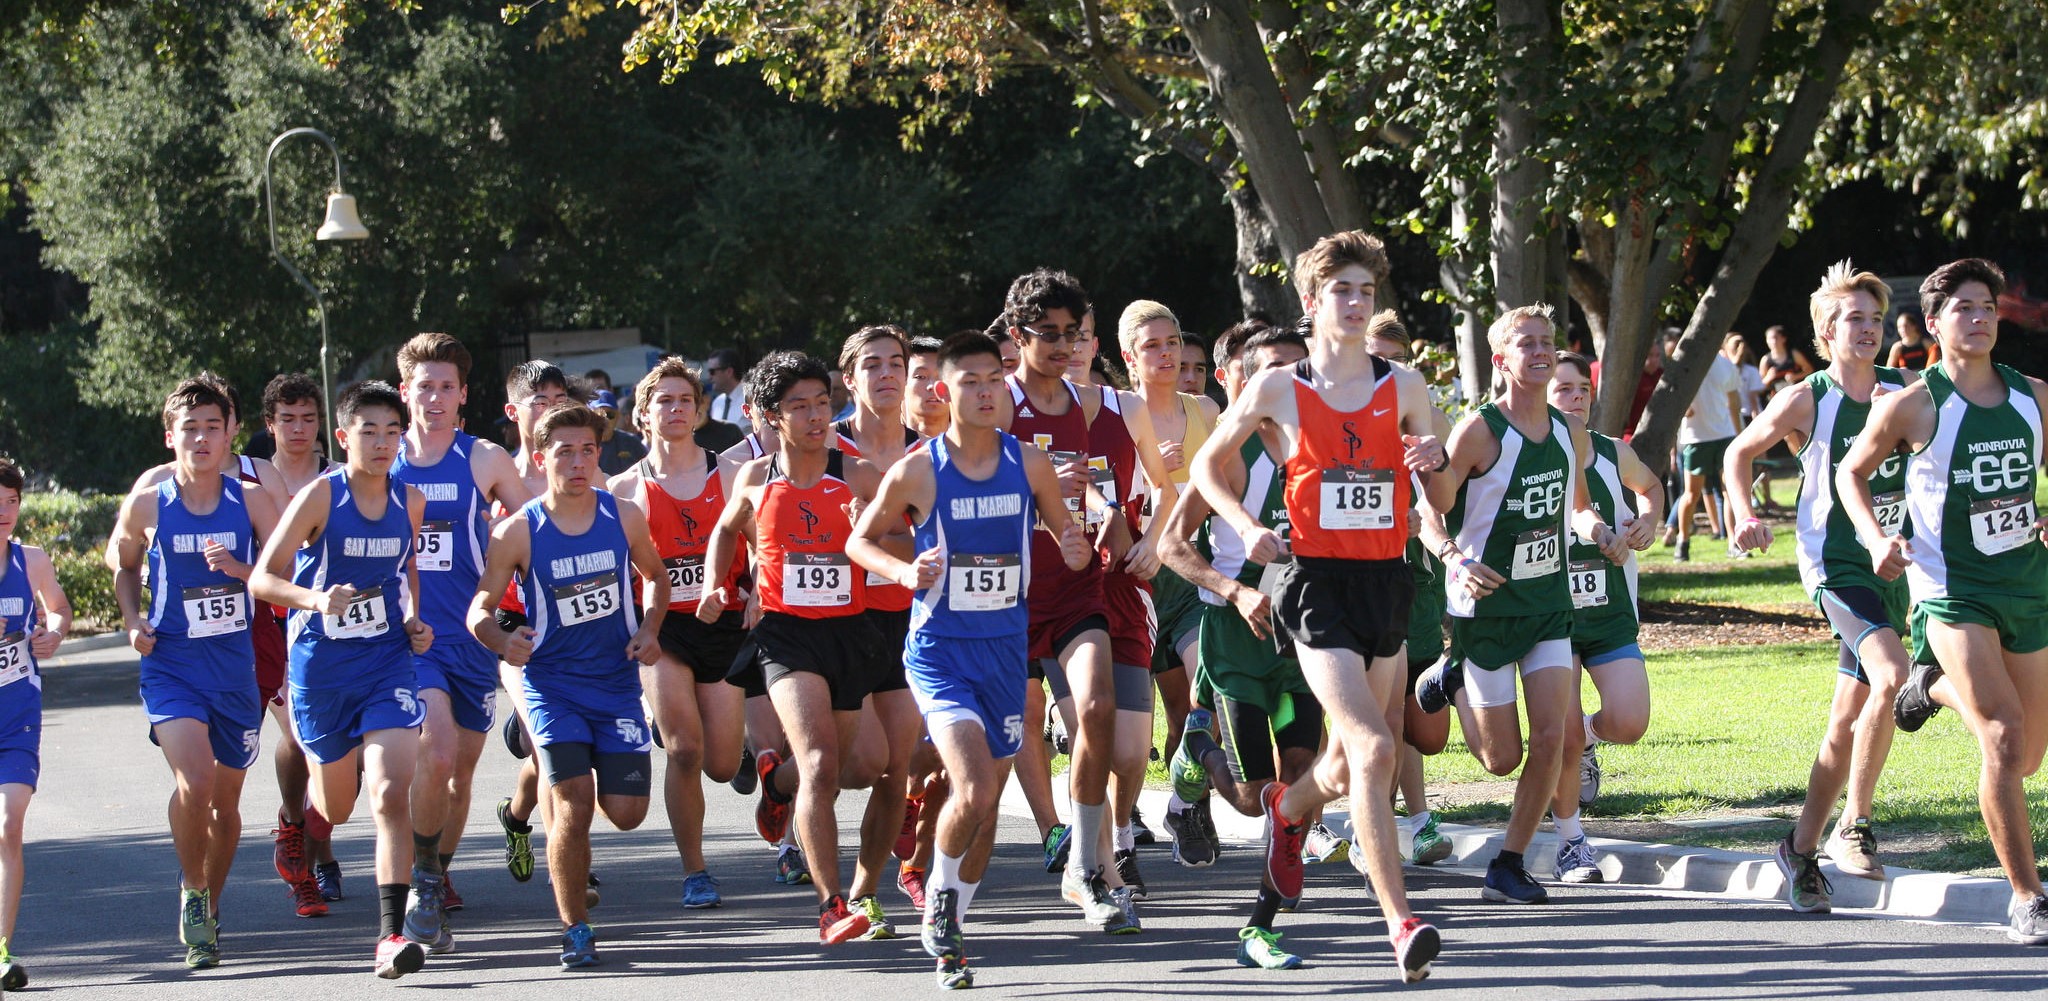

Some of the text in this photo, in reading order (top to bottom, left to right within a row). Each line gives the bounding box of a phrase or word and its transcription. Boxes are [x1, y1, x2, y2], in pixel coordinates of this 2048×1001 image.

[1968, 438, 2026, 454] MONROVIA
[1521, 468, 1564, 486] MONROVIA
[1971, 451, 2028, 493] CC
[951, 493, 1021, 520] SAN MARINO
[1336, 486, 1382, 510] 185
[1523, 481, 1563, 520] CC
[1984, 507, 2029, 536] 124
[173, 531, 237, 553] SAN MRINO
[344, 537, 401, 557] SAN MARINO
[1525, 538, 1555, 564] 120
[551, 549, 616, 579] SAN MARINO
[668, 565, 705, 587] 208
[797, 567, 839, 589] 193
[964, 569, 1006, 592] 151
[1572, 573, 1596, 593] 18
[197, 597, 236, 621] 155
[571, 589, 613, 618] 153
